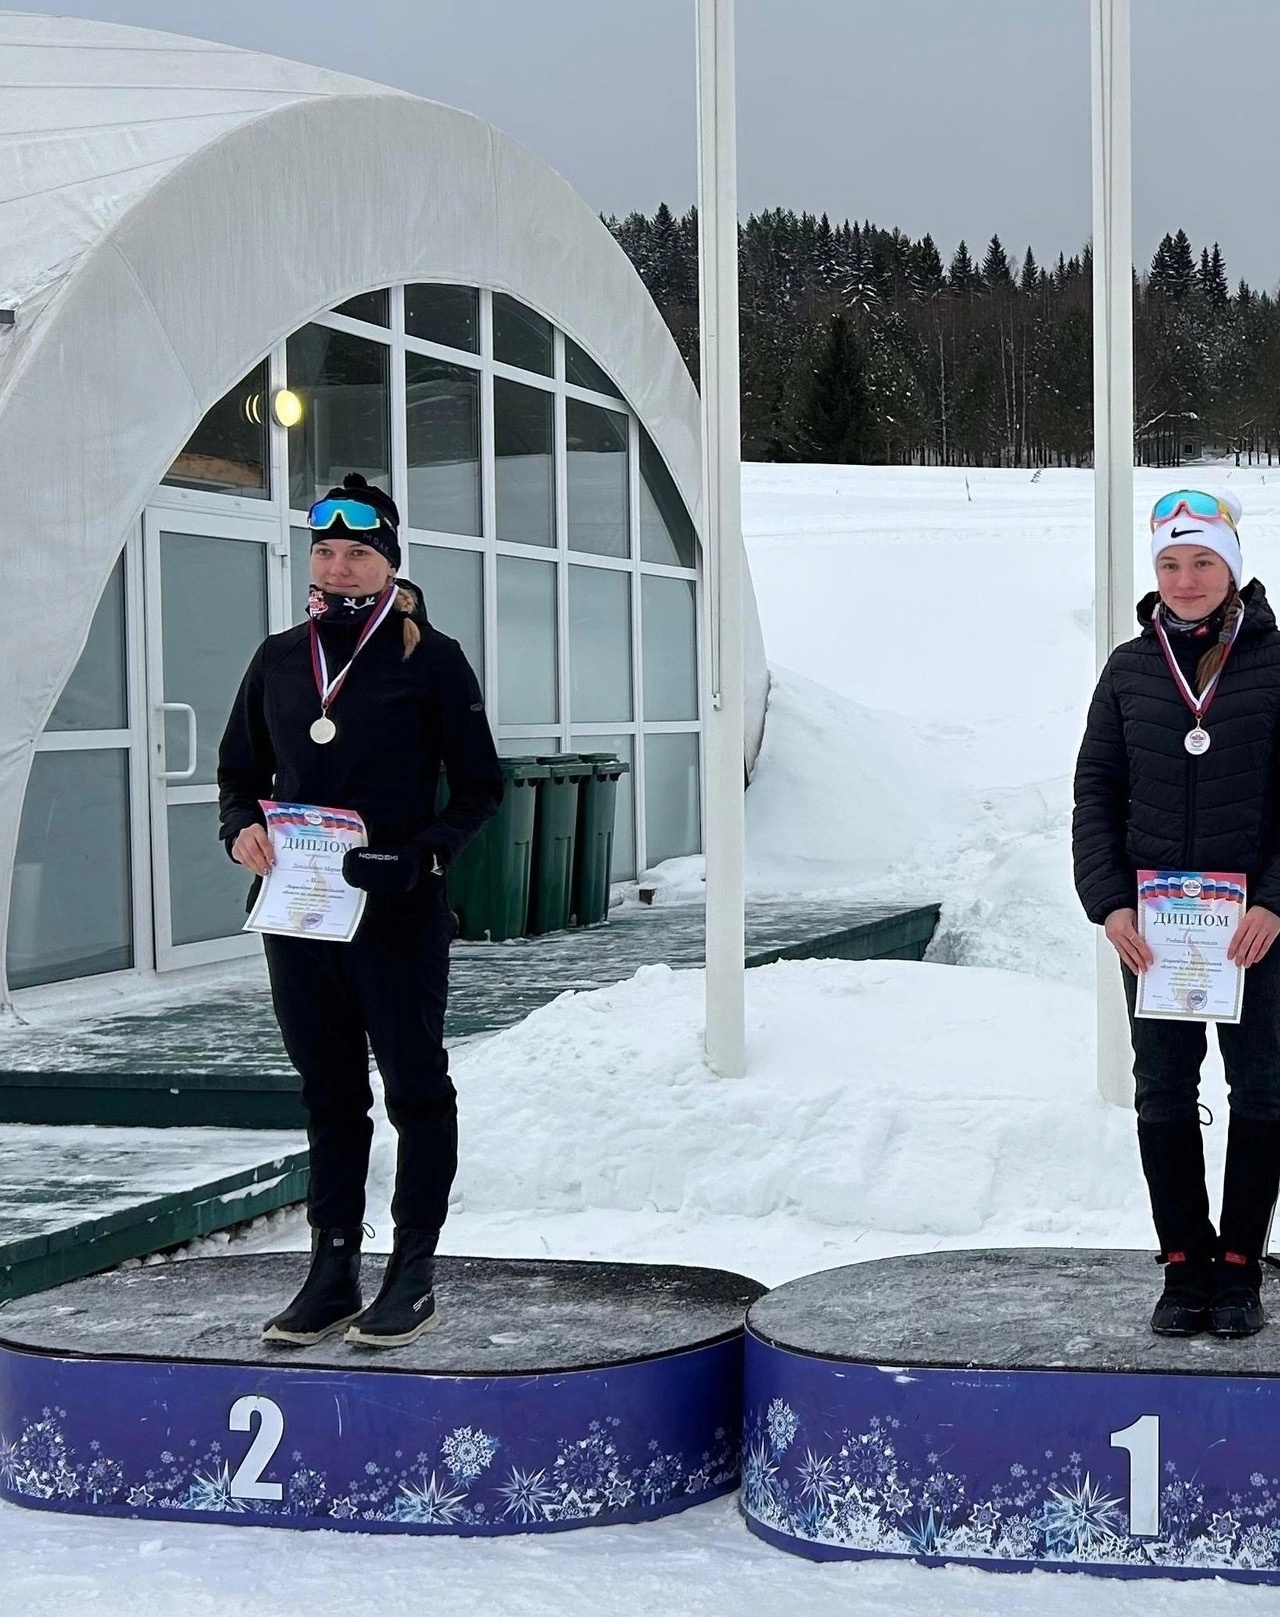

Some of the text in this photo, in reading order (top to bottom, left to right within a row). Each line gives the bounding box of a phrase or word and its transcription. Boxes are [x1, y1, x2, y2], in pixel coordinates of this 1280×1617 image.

[282, 837, 353, 853] ДИПЛОМ
[1153, 911, 1230, 927] ДИПЛОМ
[229, 1394, 285, 1501] 2
[1109, 1414, 1161, 1536] 1
